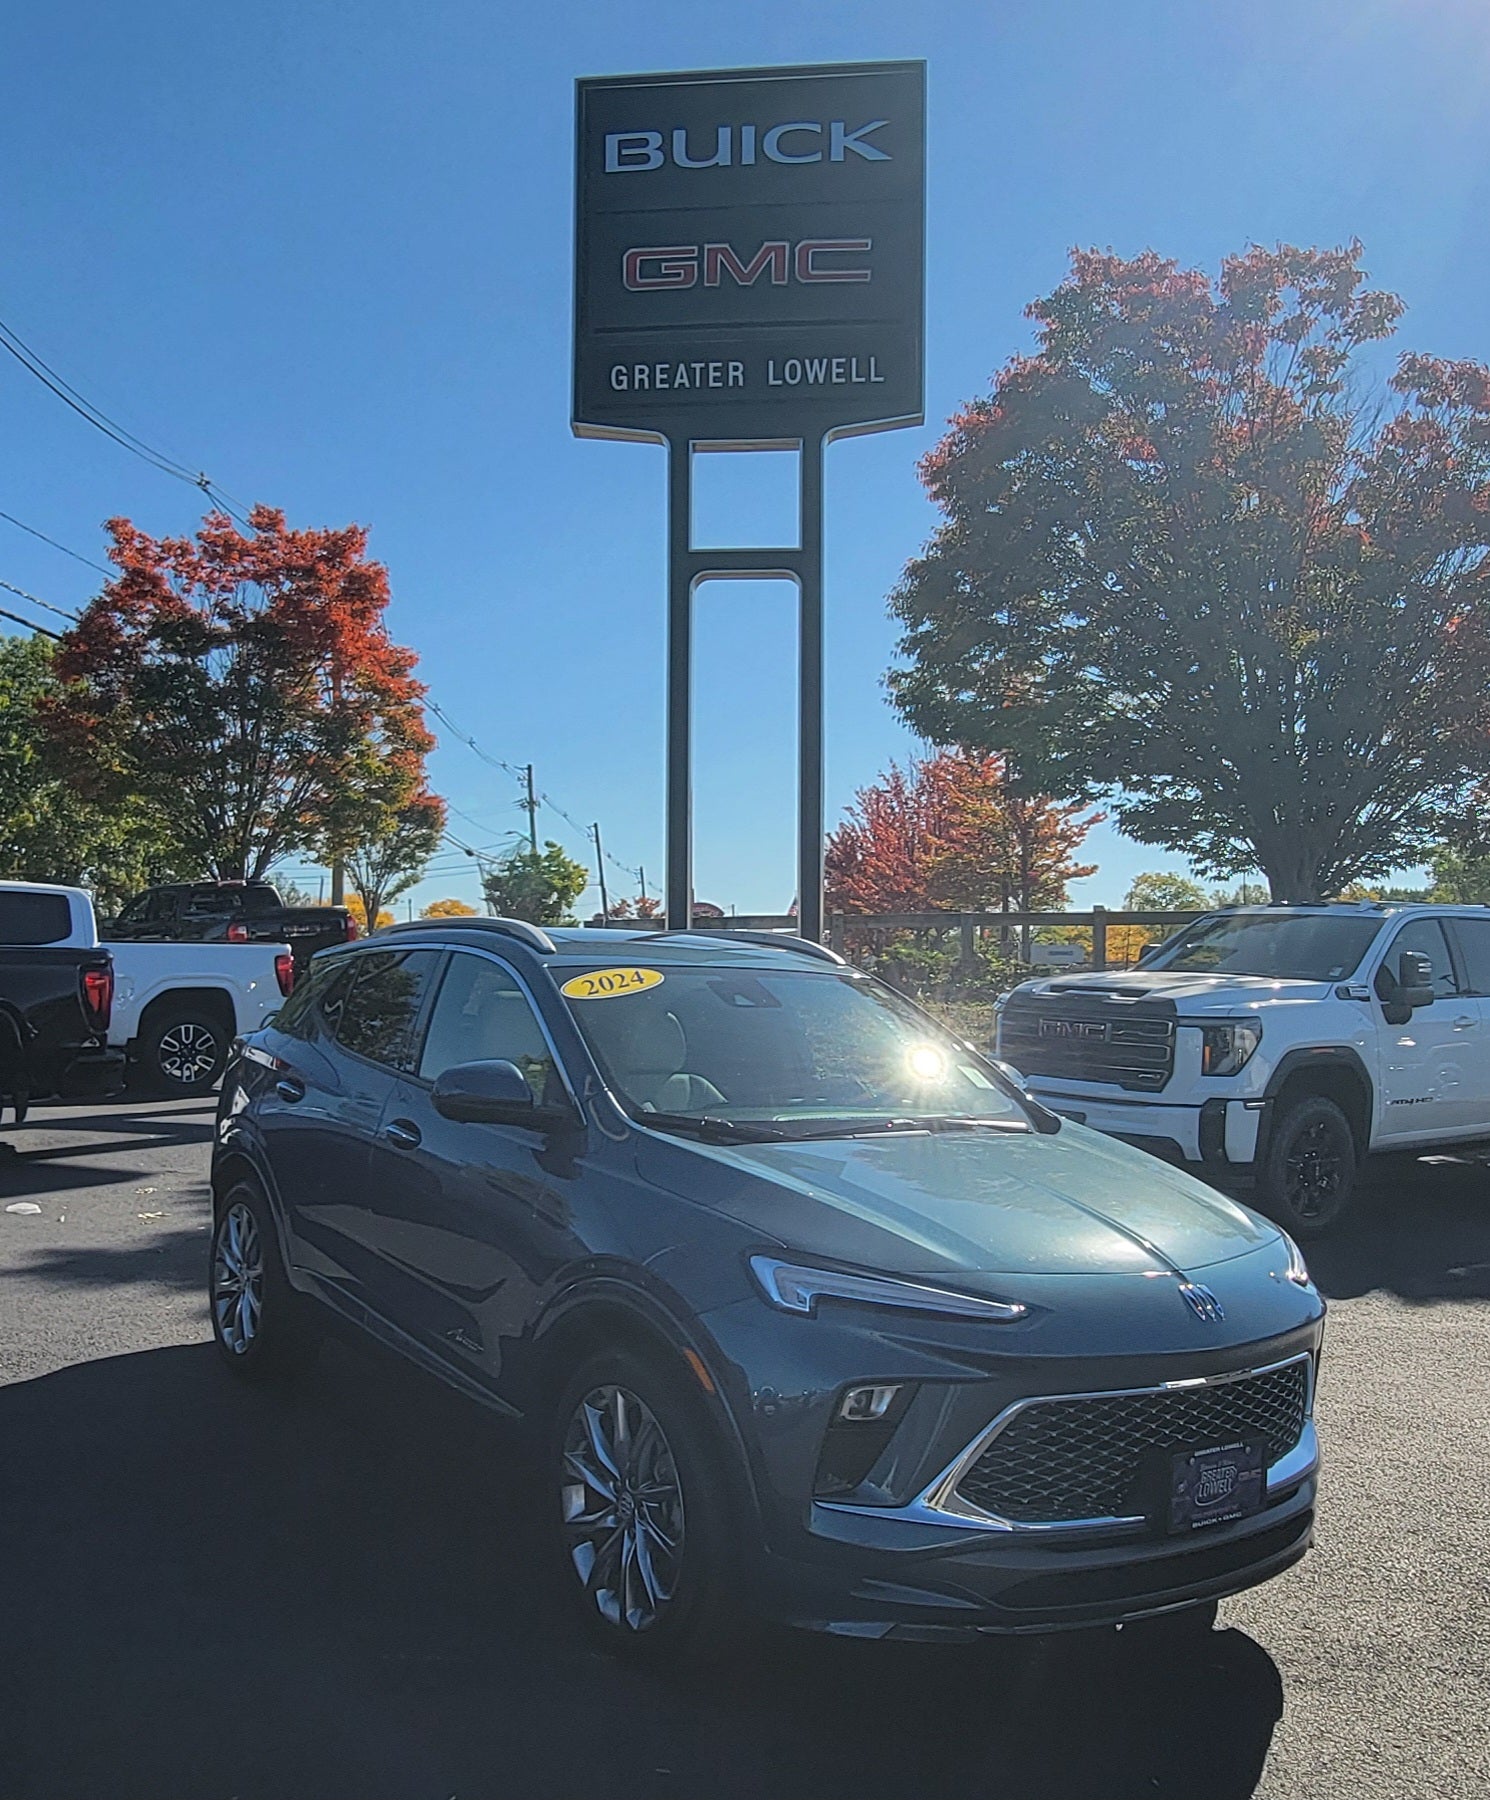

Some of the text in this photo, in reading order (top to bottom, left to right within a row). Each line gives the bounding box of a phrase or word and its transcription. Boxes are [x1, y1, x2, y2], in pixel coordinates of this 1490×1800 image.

[604, 119, 893, 173] BUICK
[622, 238, 872, 292] GMC
[610, 356, 885, 391] GREATER LOWELL
[582, 971, 645, 995] 2024
